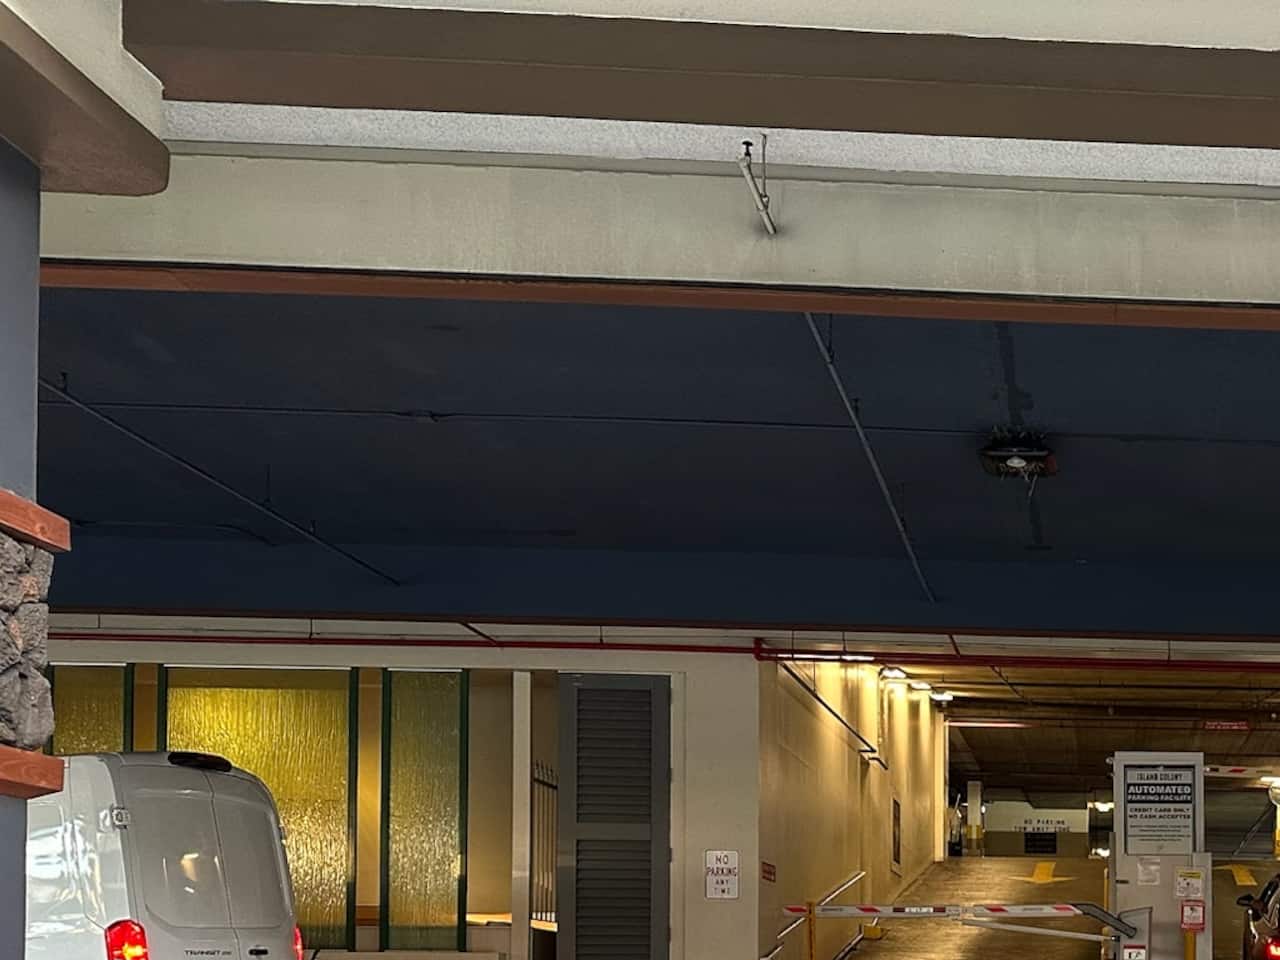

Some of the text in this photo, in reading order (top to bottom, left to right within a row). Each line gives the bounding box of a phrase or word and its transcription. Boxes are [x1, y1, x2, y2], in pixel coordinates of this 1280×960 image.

[1128, 785, 1191, 794] AUTOMATED
[715, 854, 729, 865] NO
[706, 866, 738, 877] PARKING
